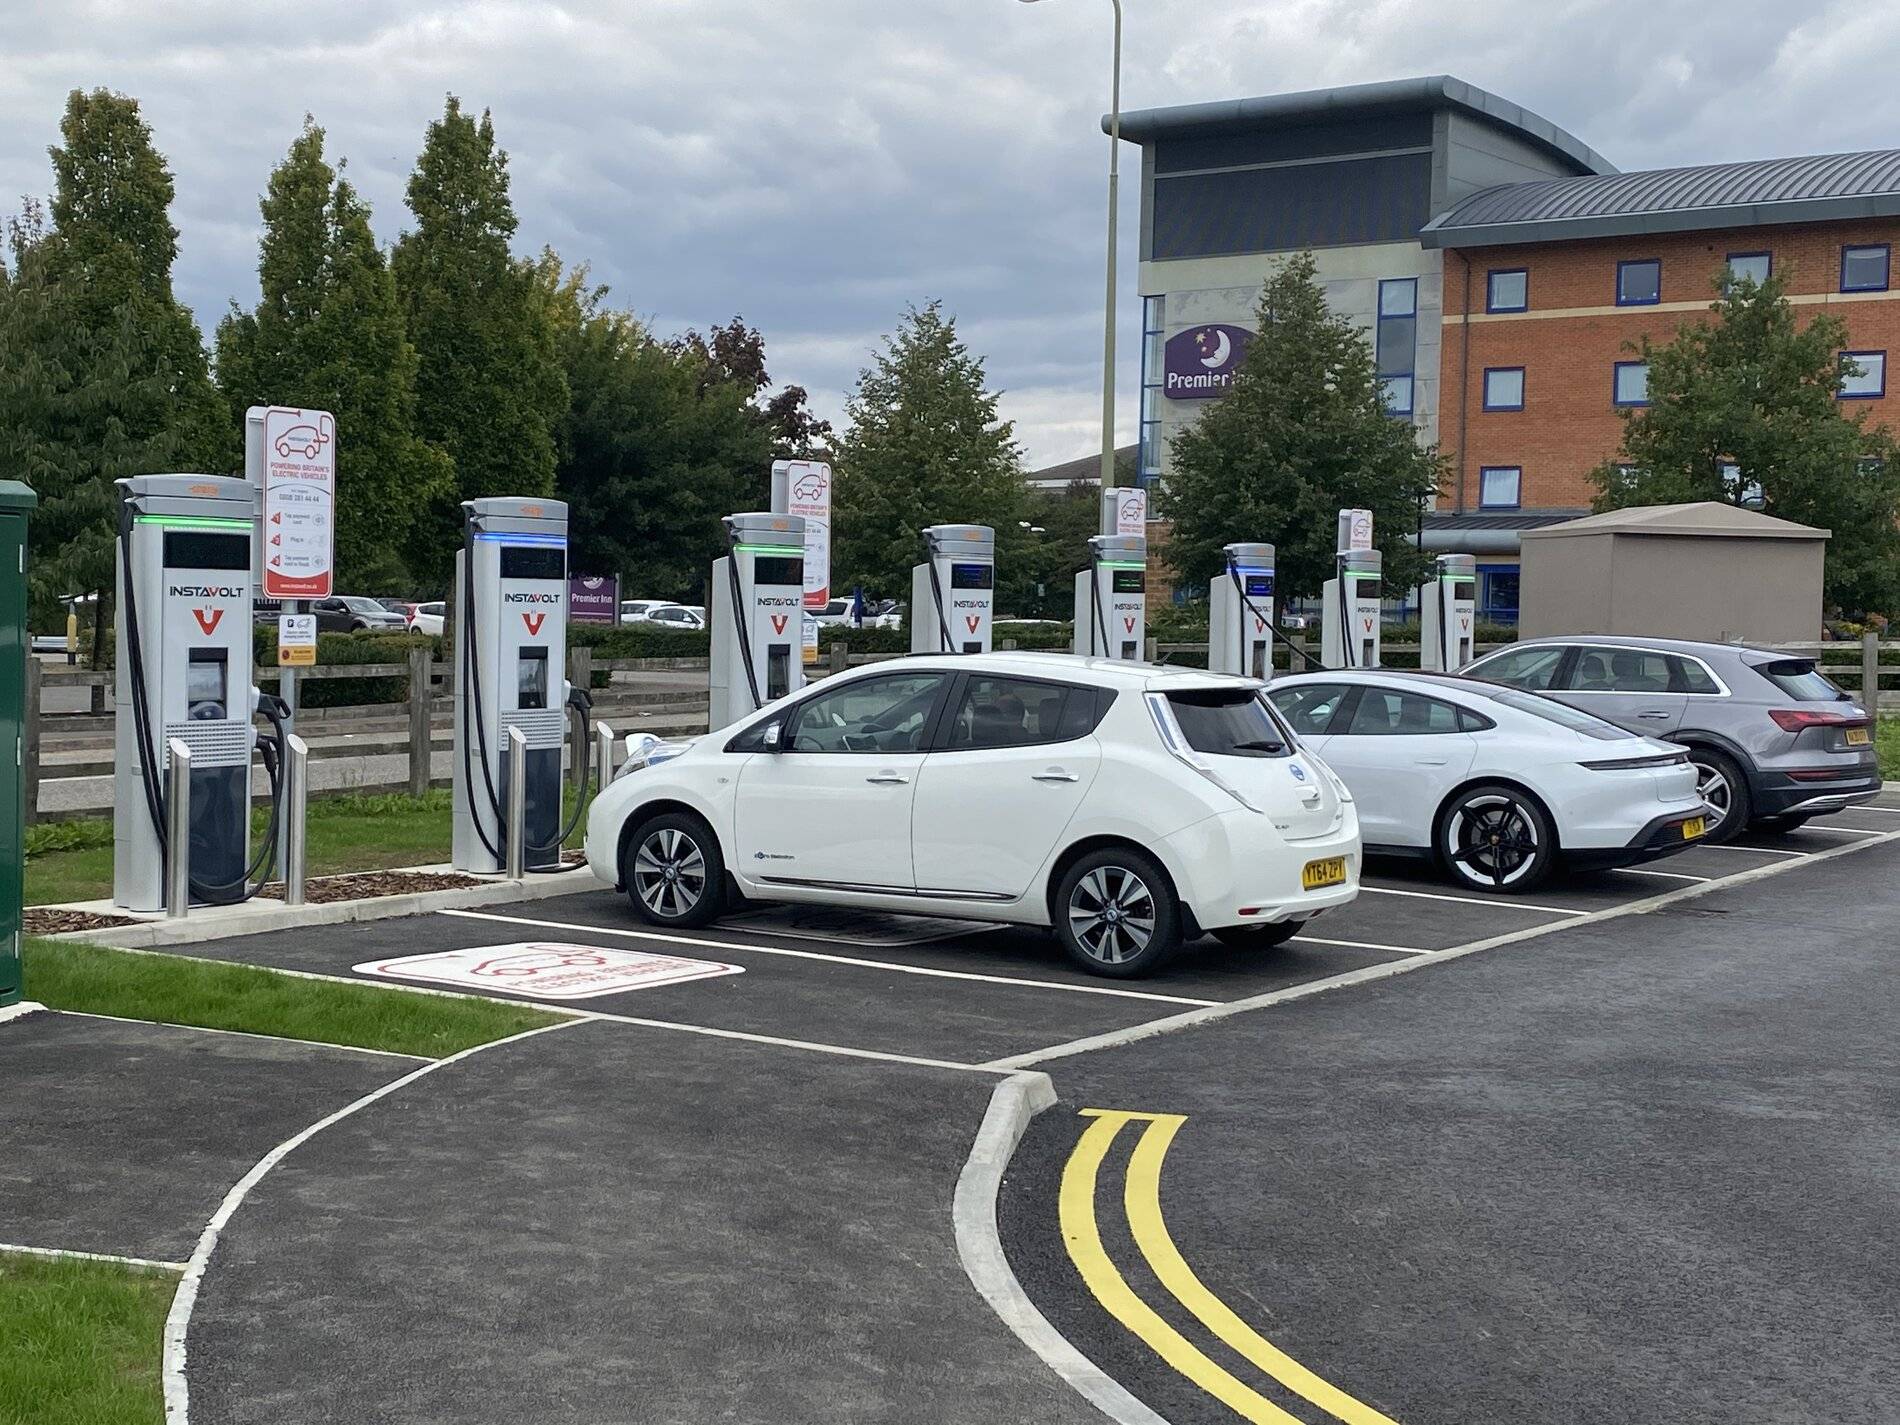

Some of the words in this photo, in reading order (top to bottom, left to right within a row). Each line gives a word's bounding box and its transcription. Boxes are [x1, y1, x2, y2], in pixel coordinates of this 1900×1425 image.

[1168, 371, 1229, 388] Premier
[169, 586, 244, 598] INSTAVOLT
[504, 593, 560, 603] INSTAVOLT
[571, 593, 600, 603] Premier
[600, 594, 613, 604] Inn
[757, 597, 799, 606] INSTAVOLT
[953, 600, 990, 608] INSTAVOLT
